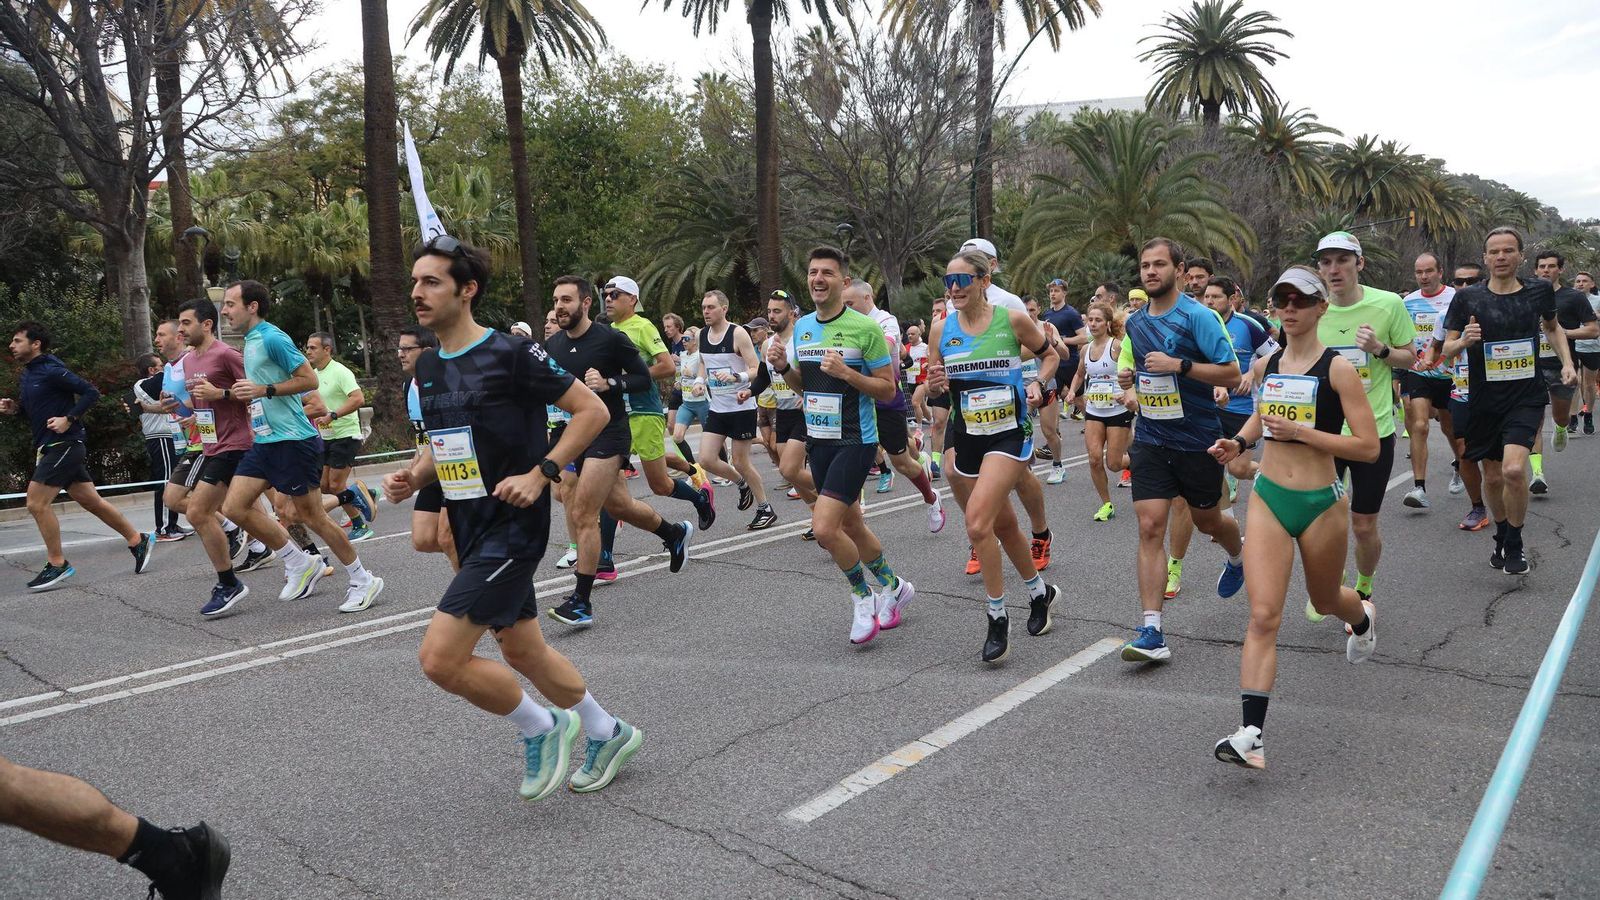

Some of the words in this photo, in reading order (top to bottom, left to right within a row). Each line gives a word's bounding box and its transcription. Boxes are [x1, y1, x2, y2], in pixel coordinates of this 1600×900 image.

[945, 359, 1010, 374] TORREMOLINOS
[1497, 358, 1528, 370] 1918
[1144, 395, 1170, 407] 1211
[810, 414, 830, 426] 264
[974, 408, 1007, 423] 3118
[1267, 404, 1297, 421] 896
[441, 463, 469, 481] 1113
